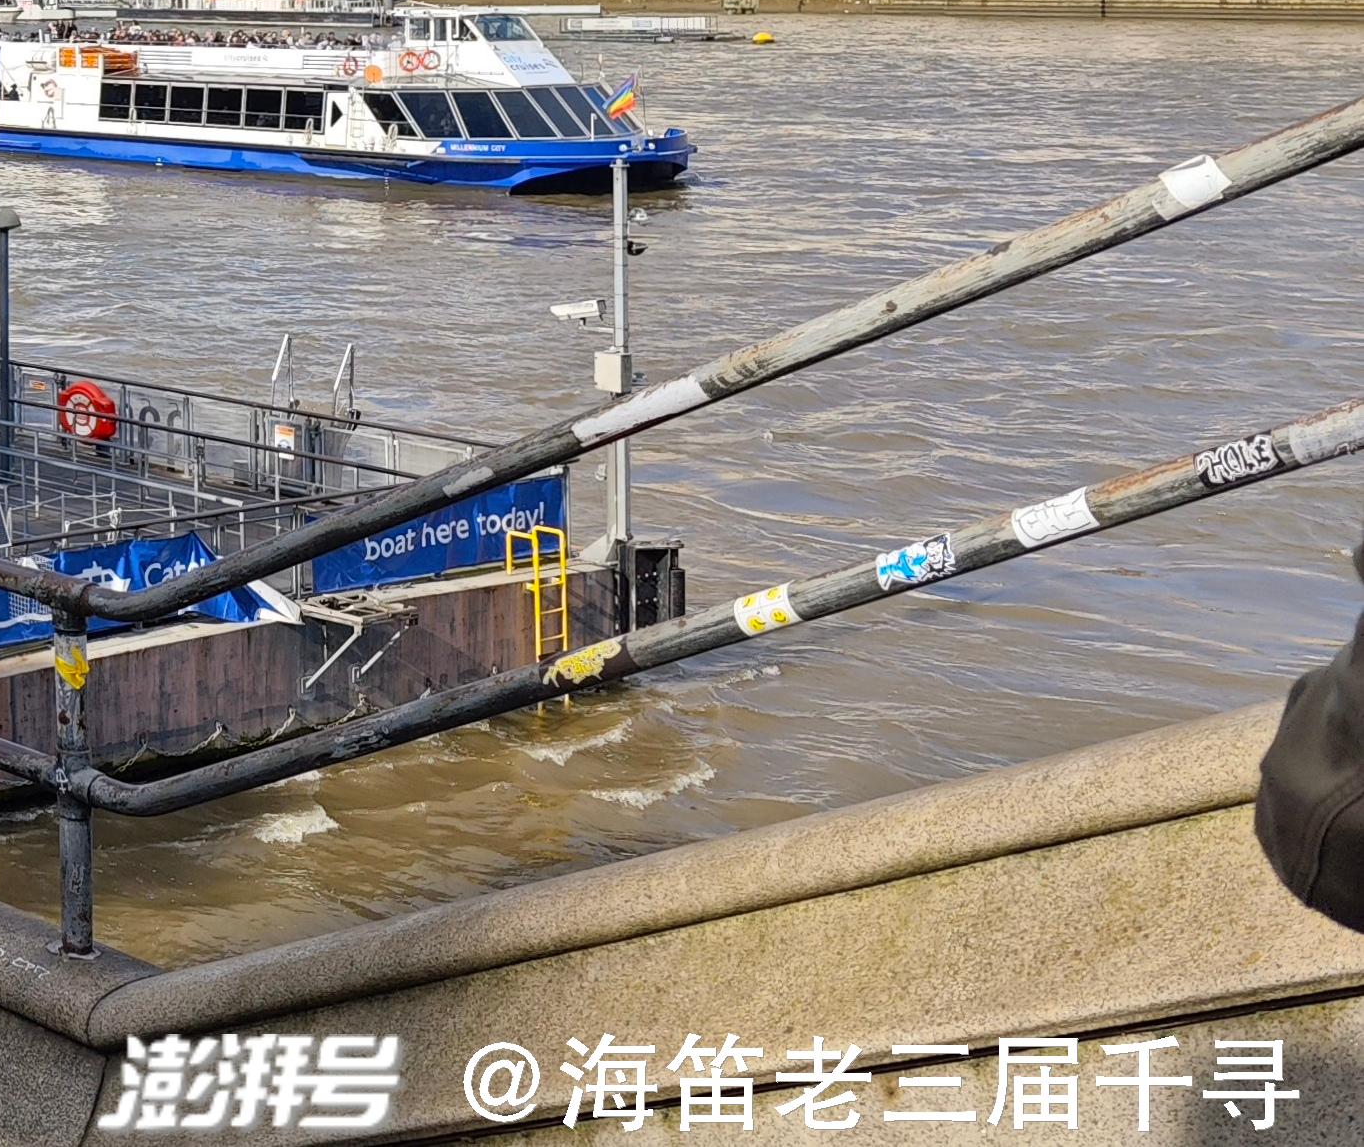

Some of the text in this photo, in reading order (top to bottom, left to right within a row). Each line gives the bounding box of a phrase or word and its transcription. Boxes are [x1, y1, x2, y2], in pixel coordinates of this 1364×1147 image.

[363, 501, 545, 561] boat here today!
